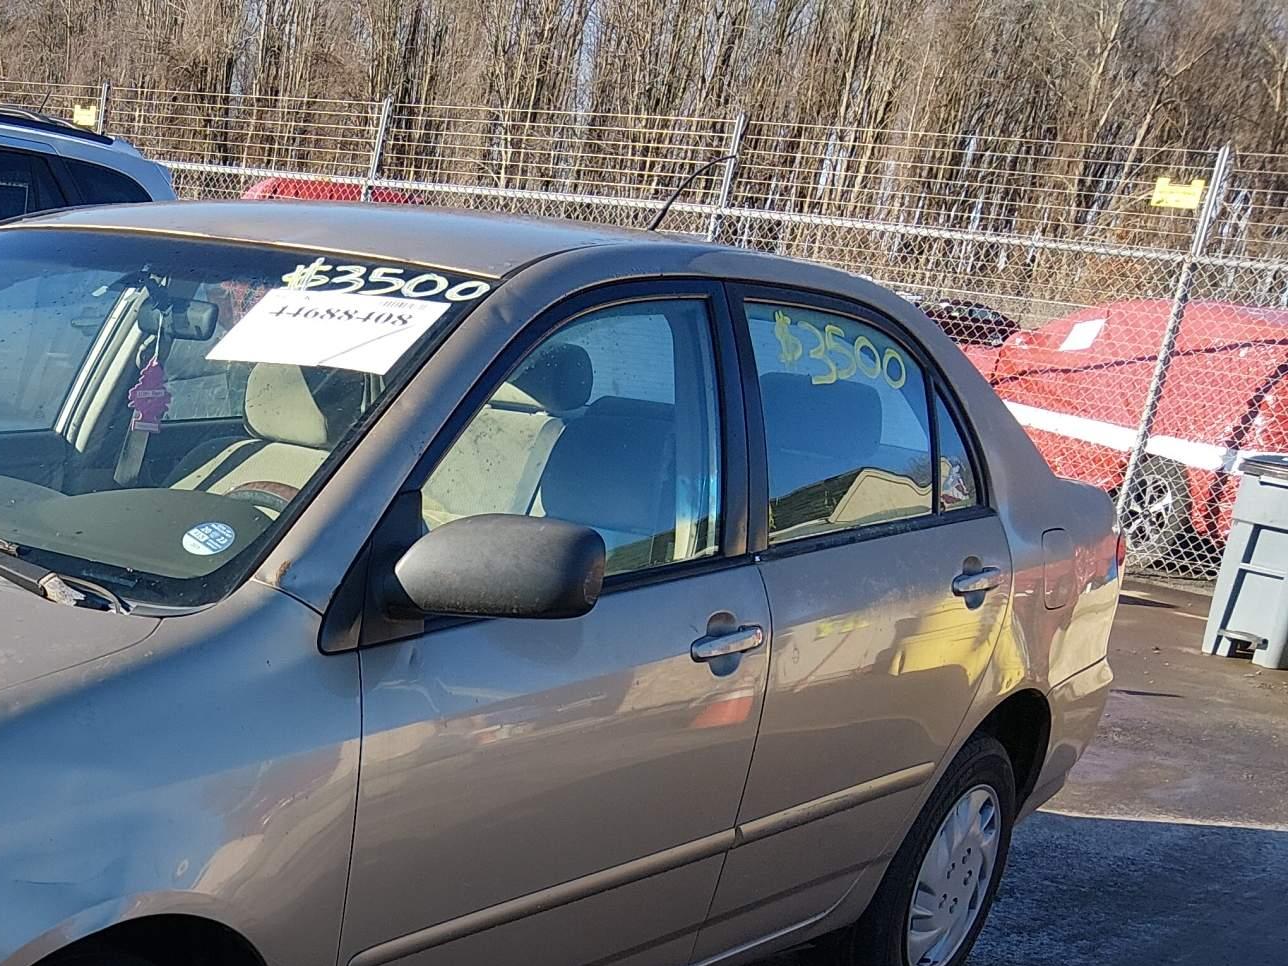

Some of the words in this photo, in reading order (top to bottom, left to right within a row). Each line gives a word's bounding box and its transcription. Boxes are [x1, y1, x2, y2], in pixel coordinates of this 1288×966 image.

[281, 256, 491, 302] $3500
[269, 304, 414, 326] 44688408
[774, 309, 907, 390] $3500
